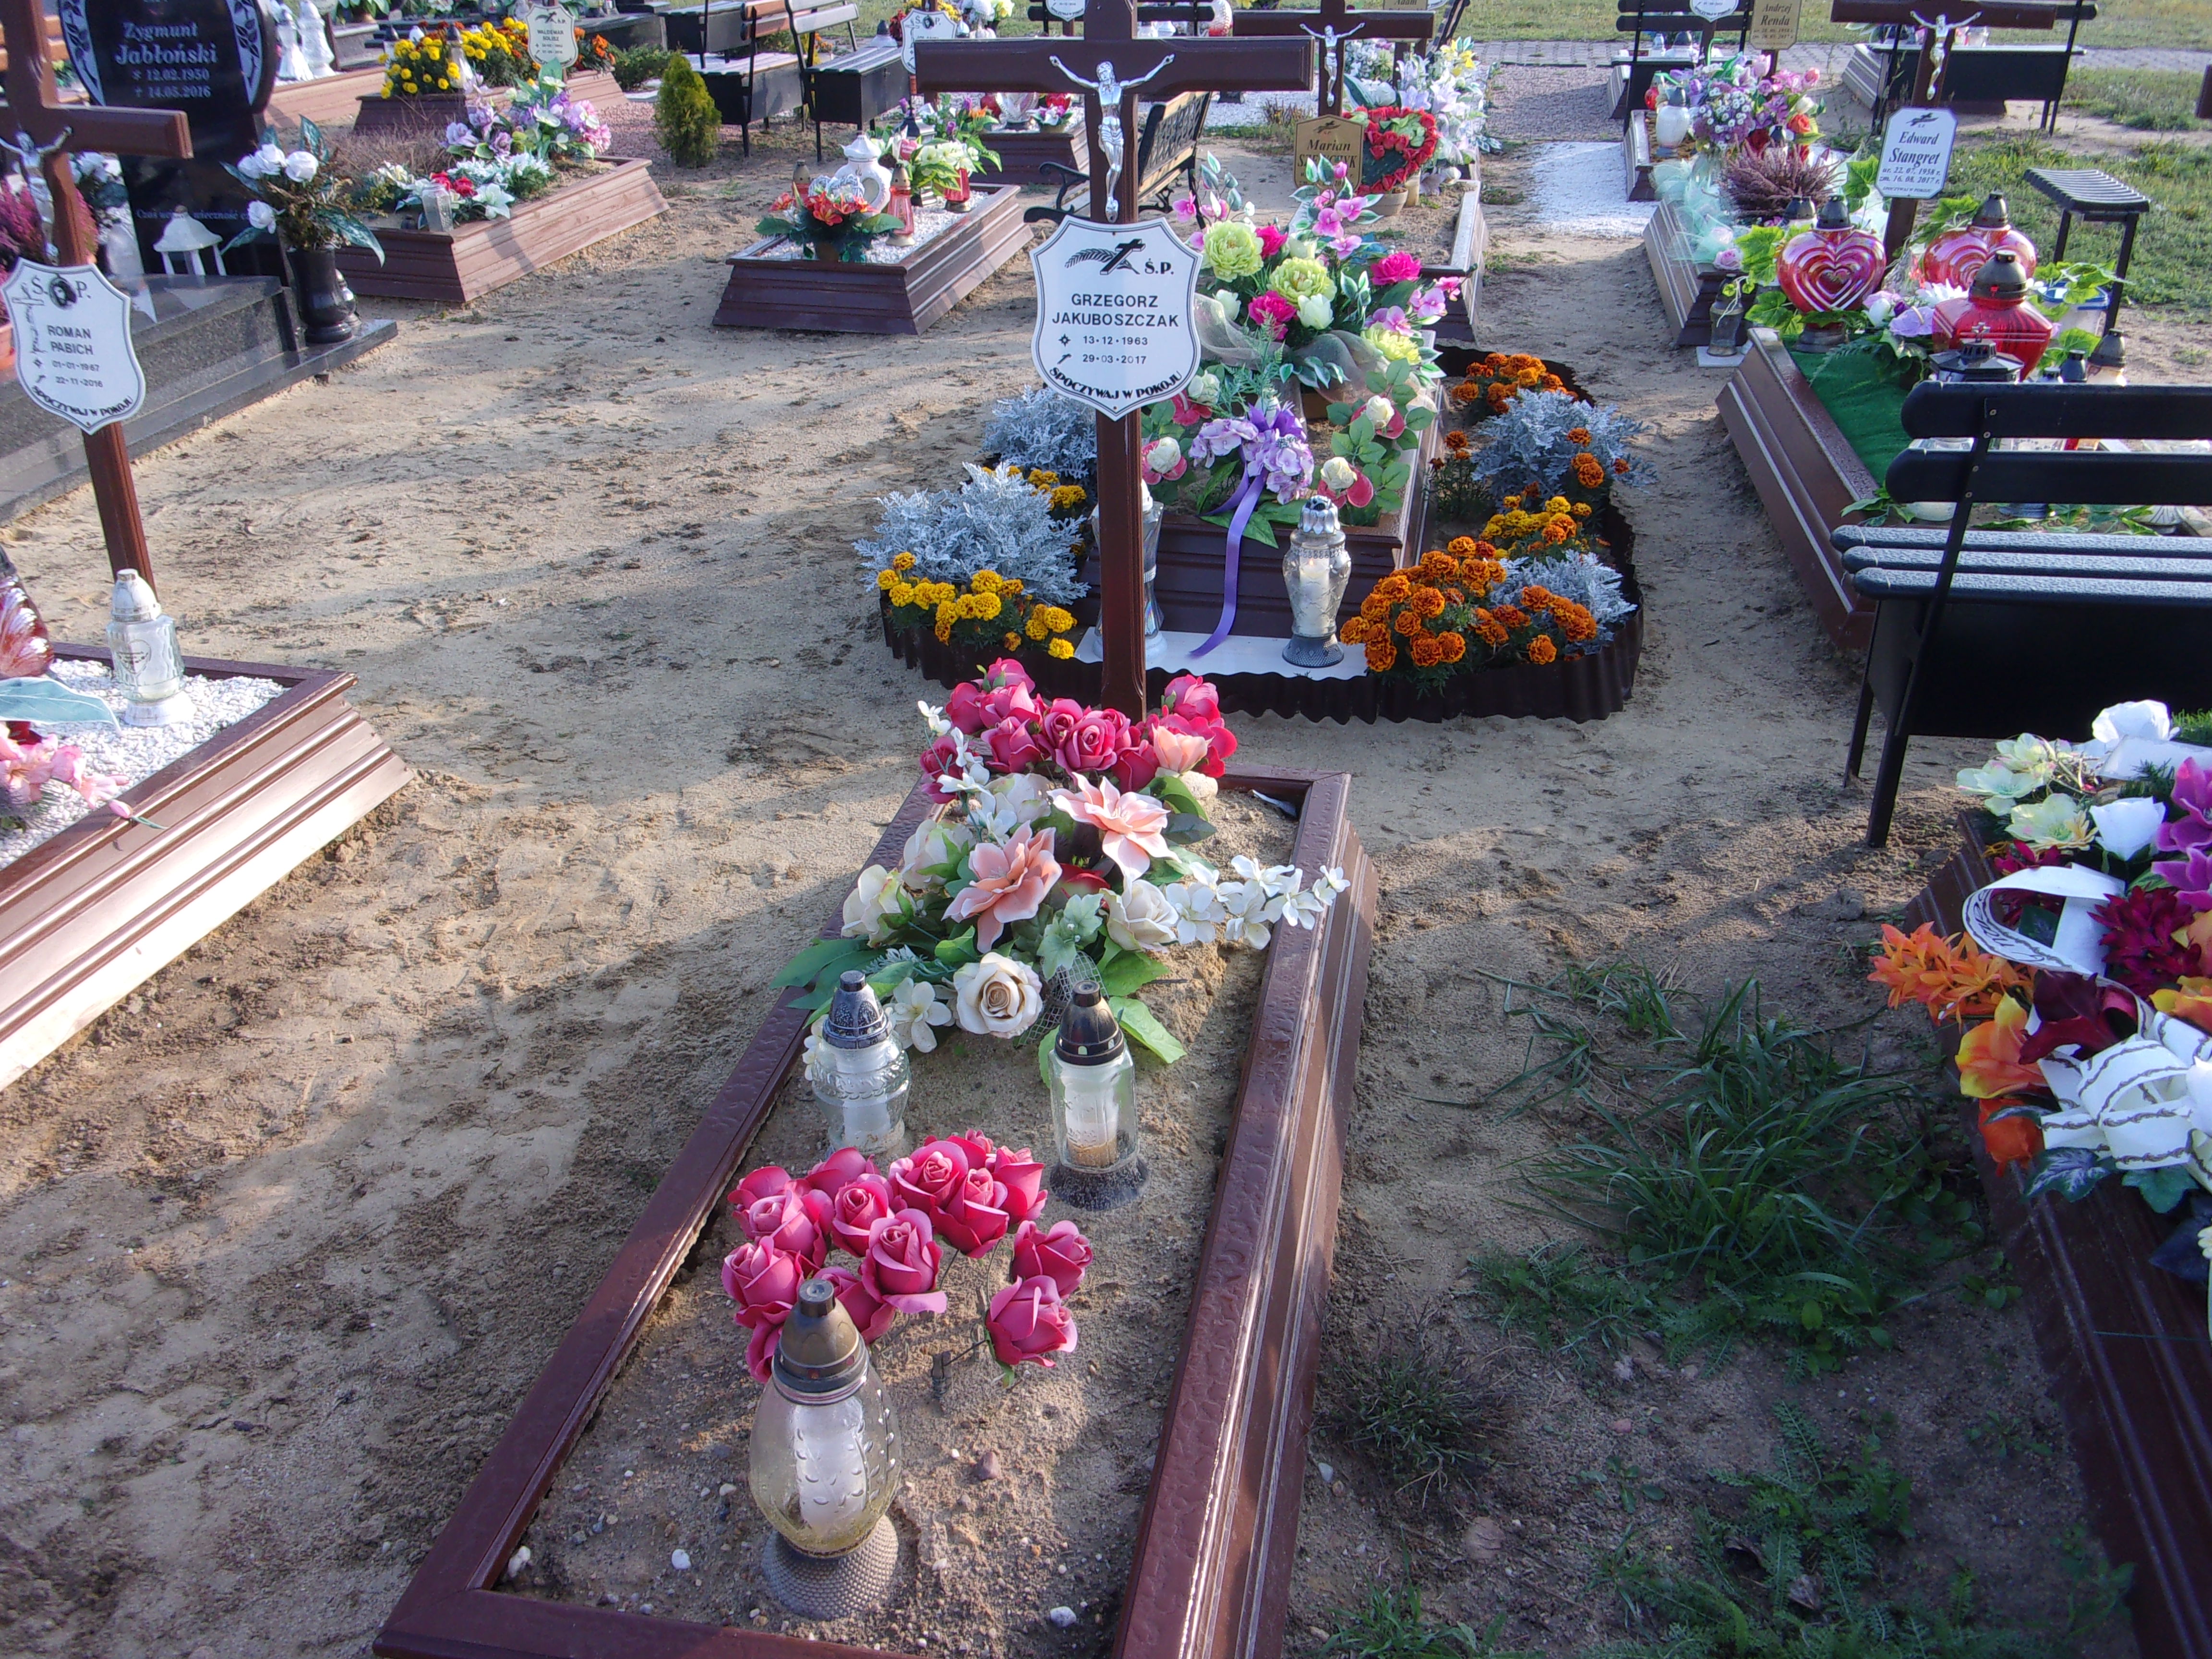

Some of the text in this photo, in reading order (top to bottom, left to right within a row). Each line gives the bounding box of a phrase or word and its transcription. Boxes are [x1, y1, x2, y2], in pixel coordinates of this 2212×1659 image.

[1762, 3, 1792, 14] Andrzej
[1760, 15, 1790, 25] Renda
[122, 22, 199, 42] Zygmunt
[115, 42, 217, 65] Jabłoński
[1307, 139, 1351, 151] Marian
[1899, 131, 1940, 145] Edward
[1888, 147, 1940, 168] Stangret
[75, 280, 91, 299] P.
[1071, 293, 1158, 308] GRZEGORZ
[1052, 312, 1179, 327] JAKUBOSZCZAK
[47, 325, 92, 339] ROMAN
[50, 341, 94, 355] PABICH
[1049, 367, 1183, 399] SPOCZYWAJ W POKOJU
